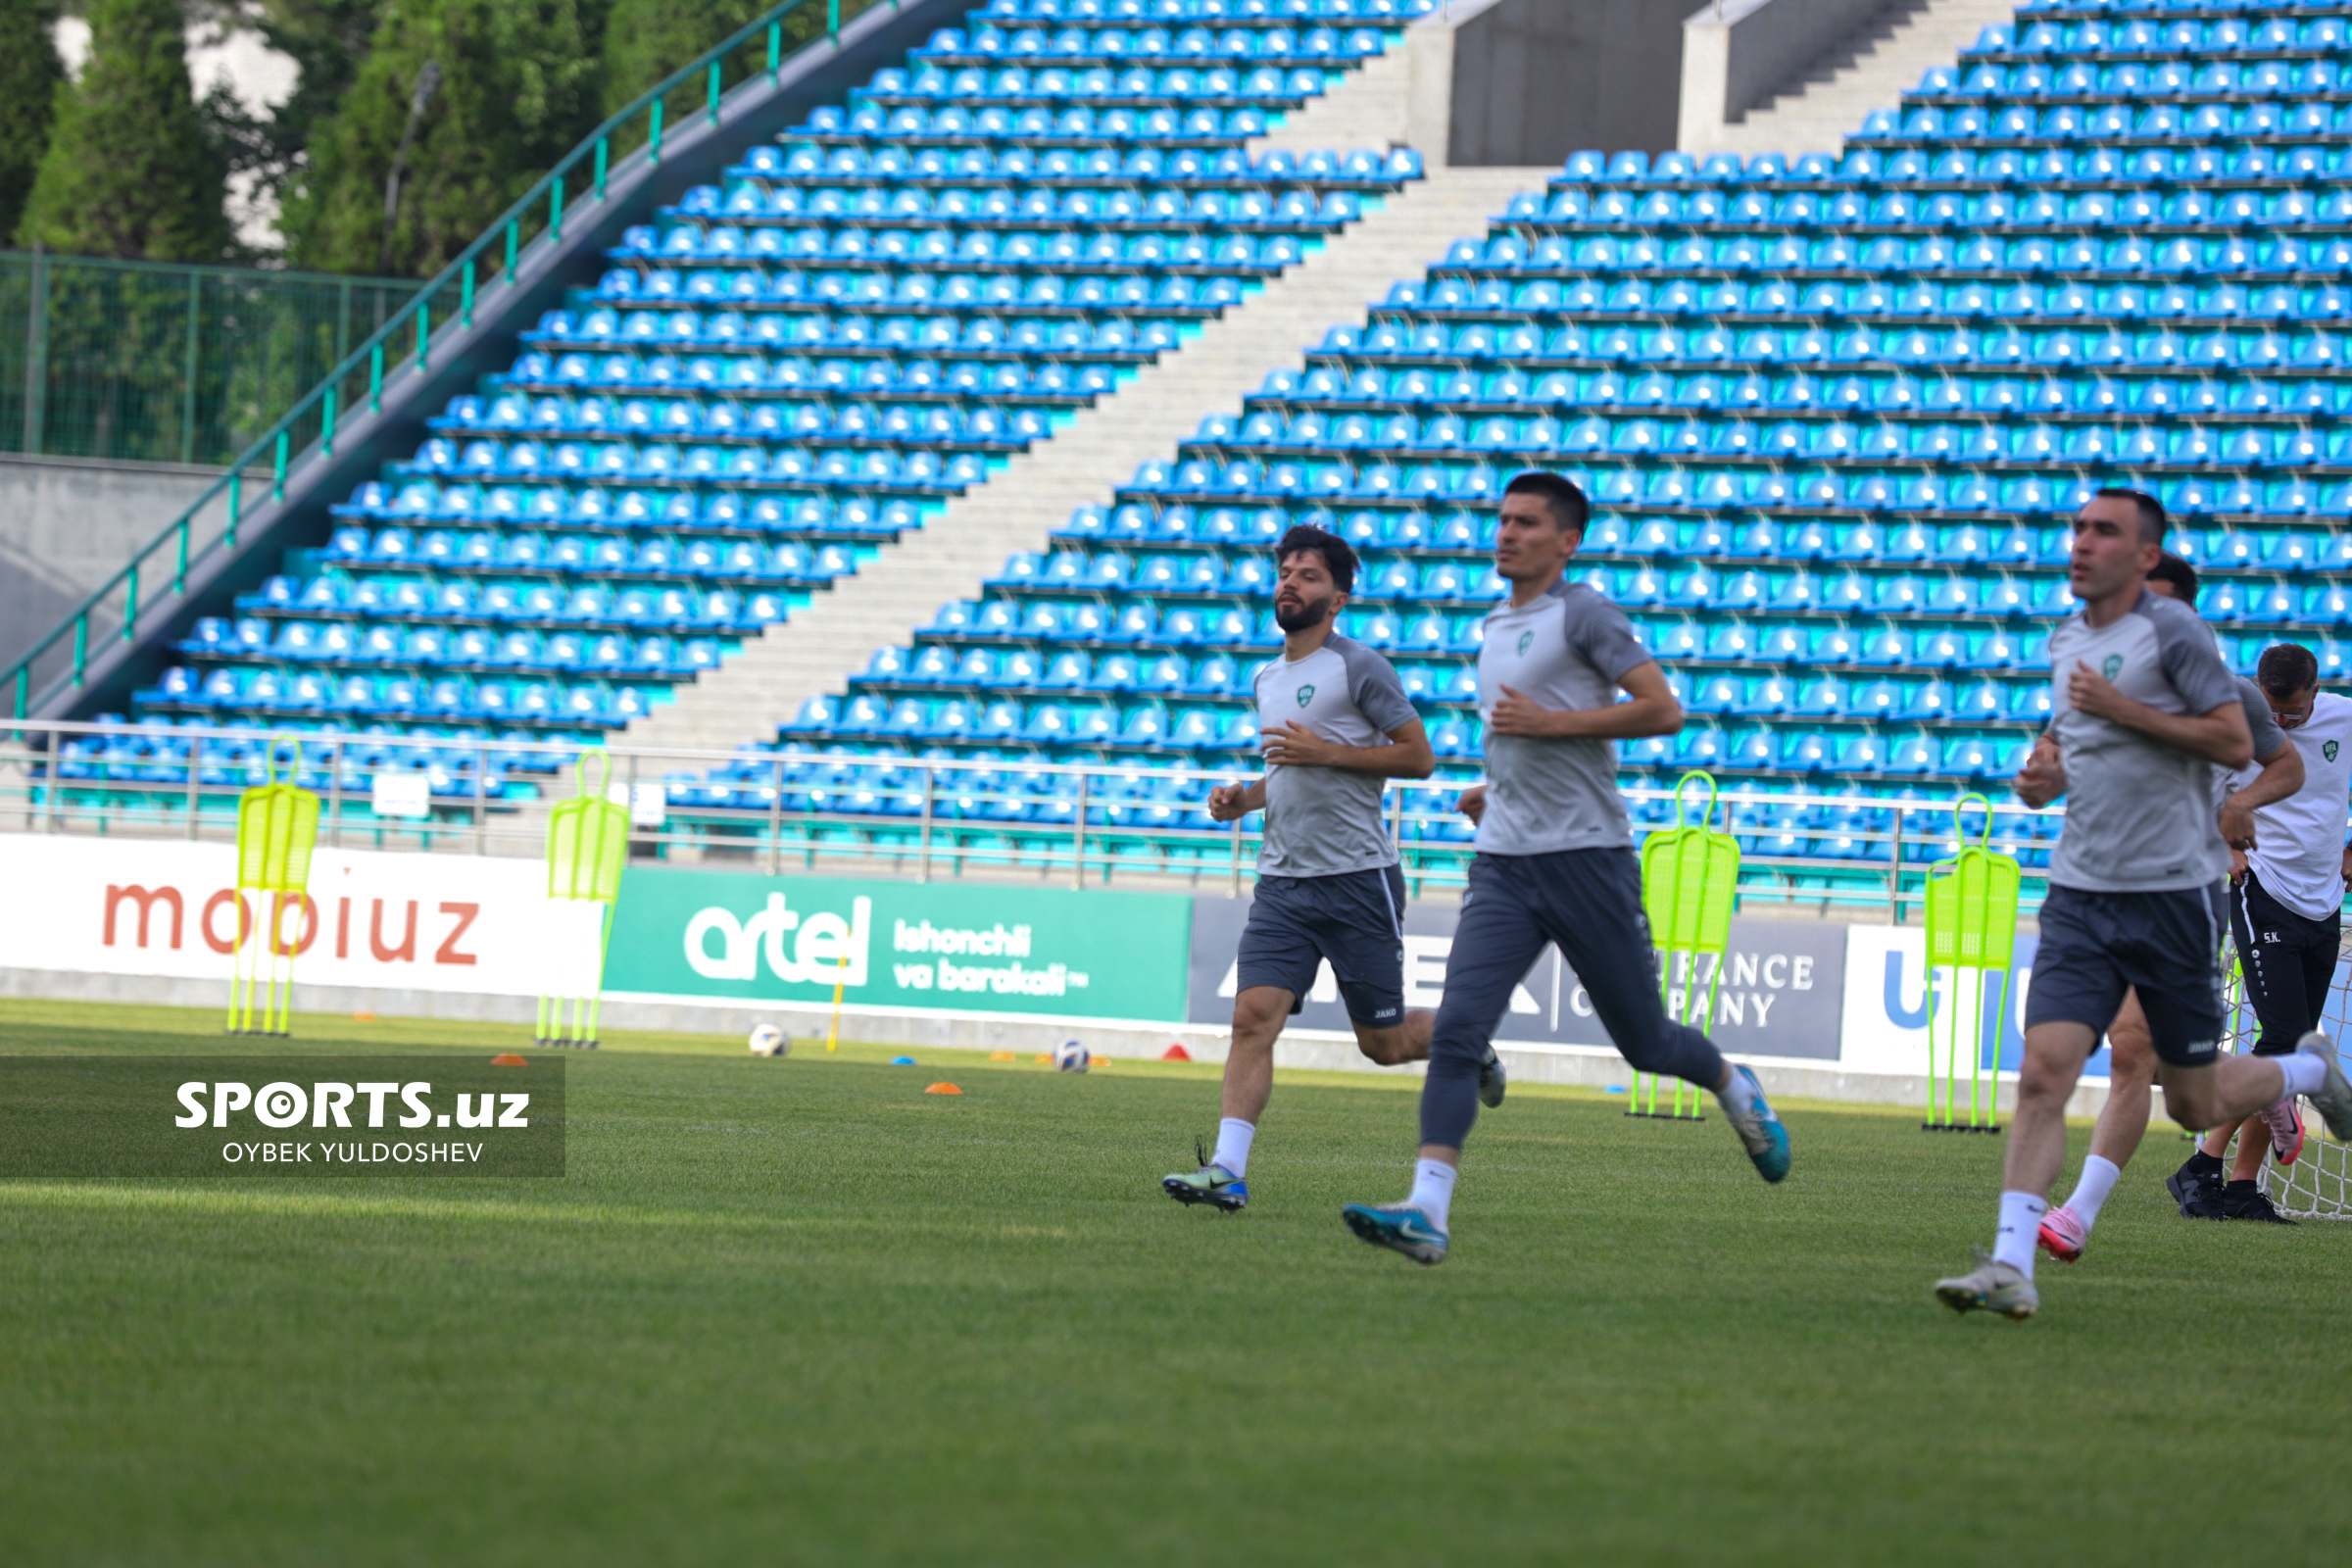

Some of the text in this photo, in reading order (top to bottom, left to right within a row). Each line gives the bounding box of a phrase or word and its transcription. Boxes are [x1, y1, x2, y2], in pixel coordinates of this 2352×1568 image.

[684, 891, 872, 987] artel
[2263, 931, 2281, 944] S.K.
[893, 962, 934, 989] va
[1374, 1007, 1396, 1019] JAKO
